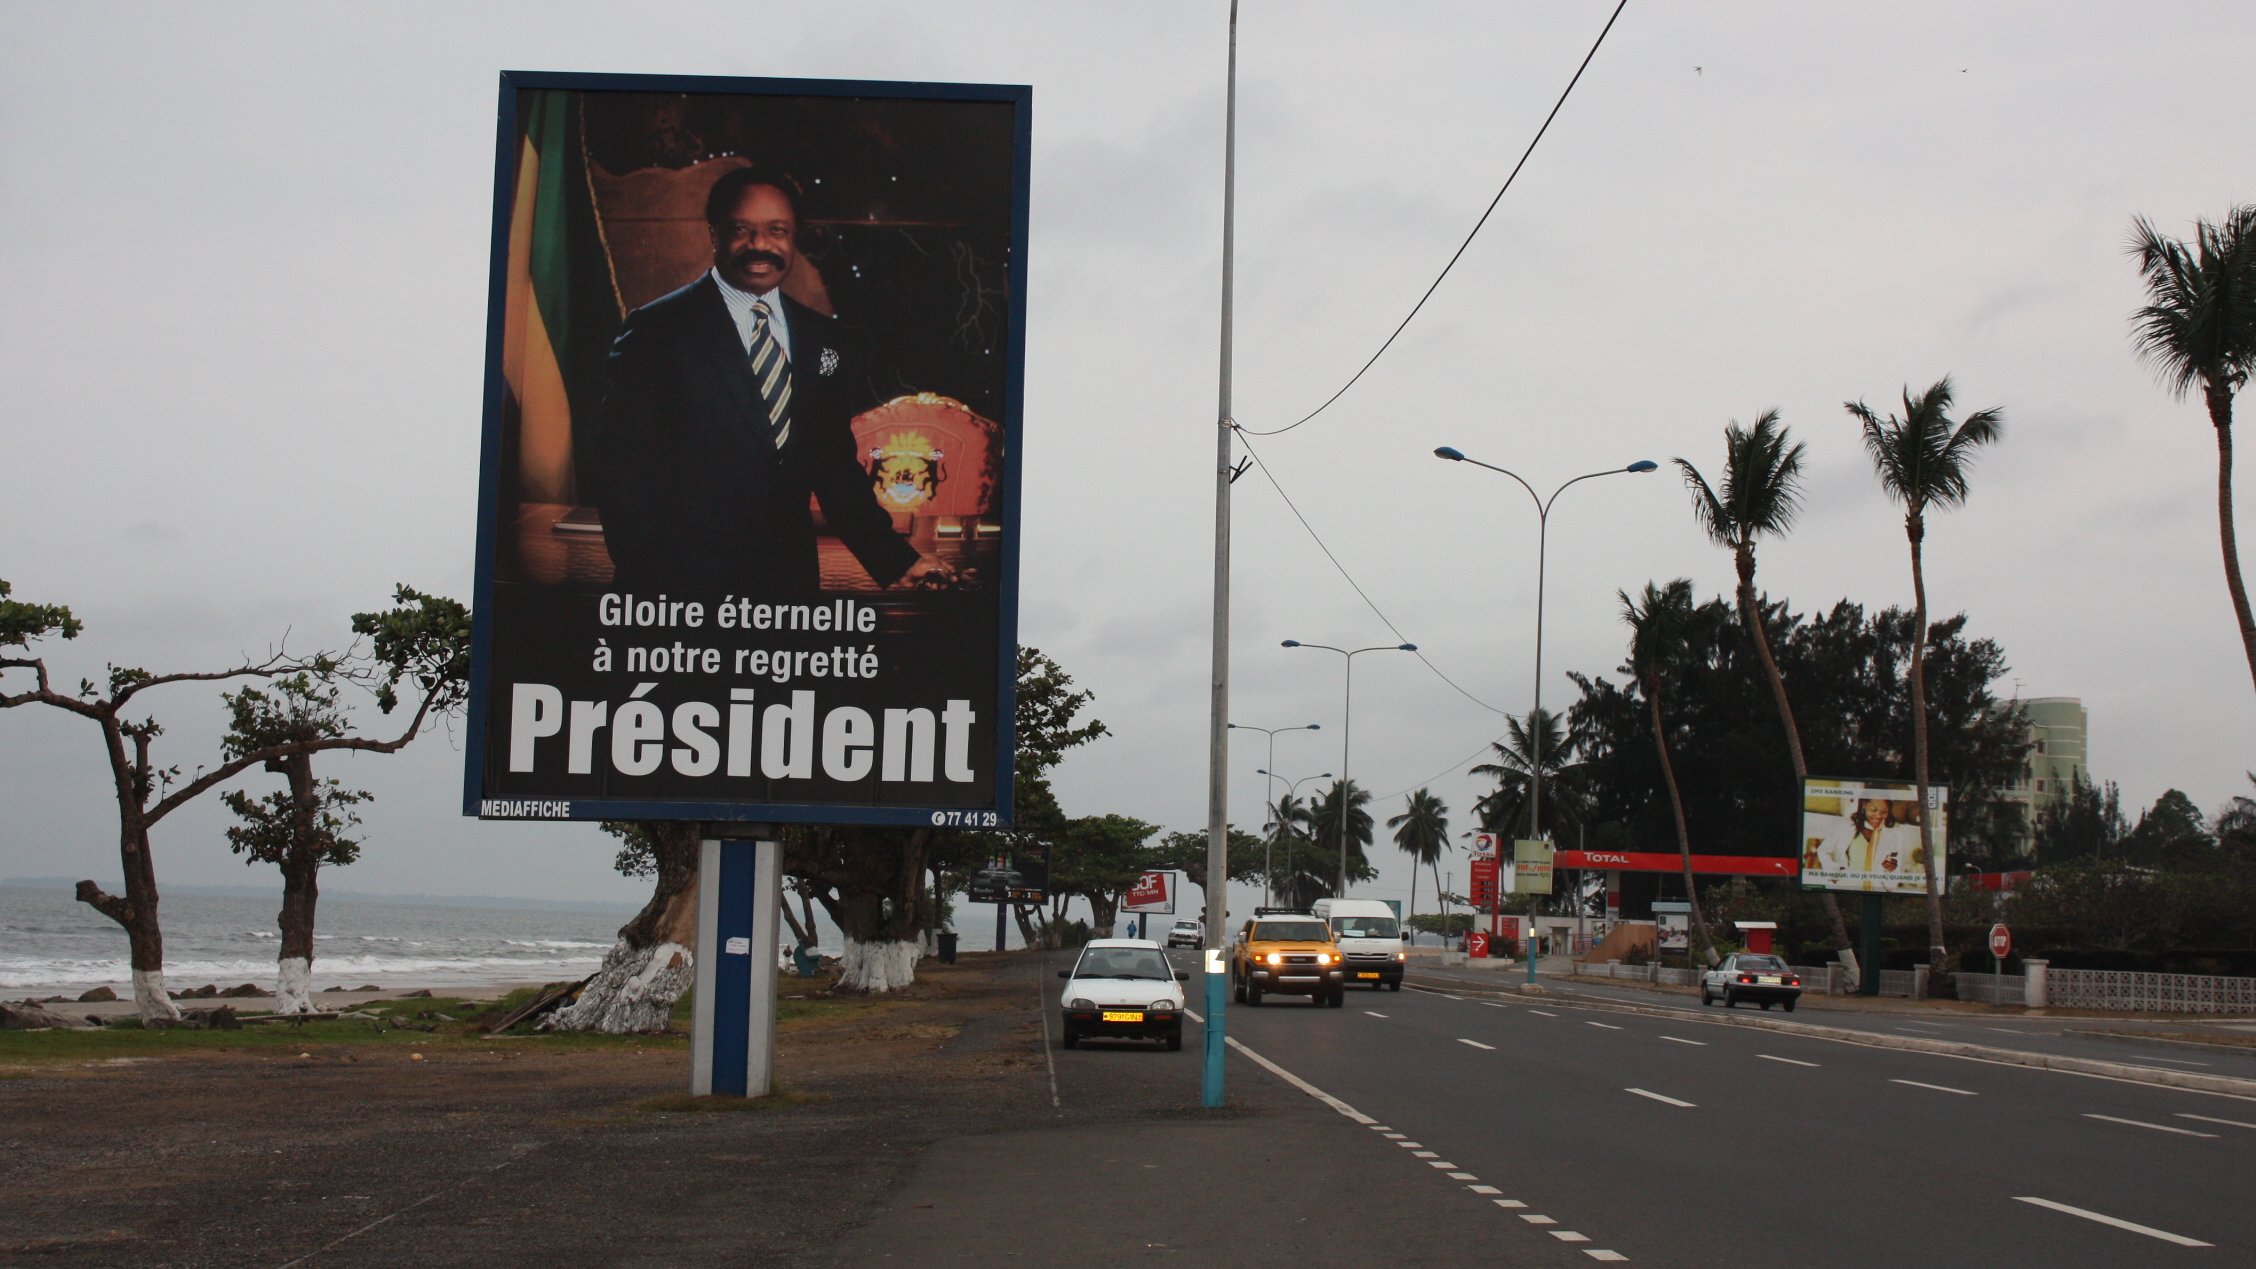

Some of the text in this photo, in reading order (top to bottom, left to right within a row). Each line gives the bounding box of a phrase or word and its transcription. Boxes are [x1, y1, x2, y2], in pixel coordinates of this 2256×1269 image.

[599, 593, 877, 633] Gloire éternelle
[592, 638, 879, 683] à notre regretté
[508, 682, 976, 783] Président
[480, 799, 571, 818] MEDIAFFICHE
[946, 811, 997, 827] 77 41 29
[1583, 852, 1630, 863] TOTAL
[1993, 935, 2007, 947] STOP
